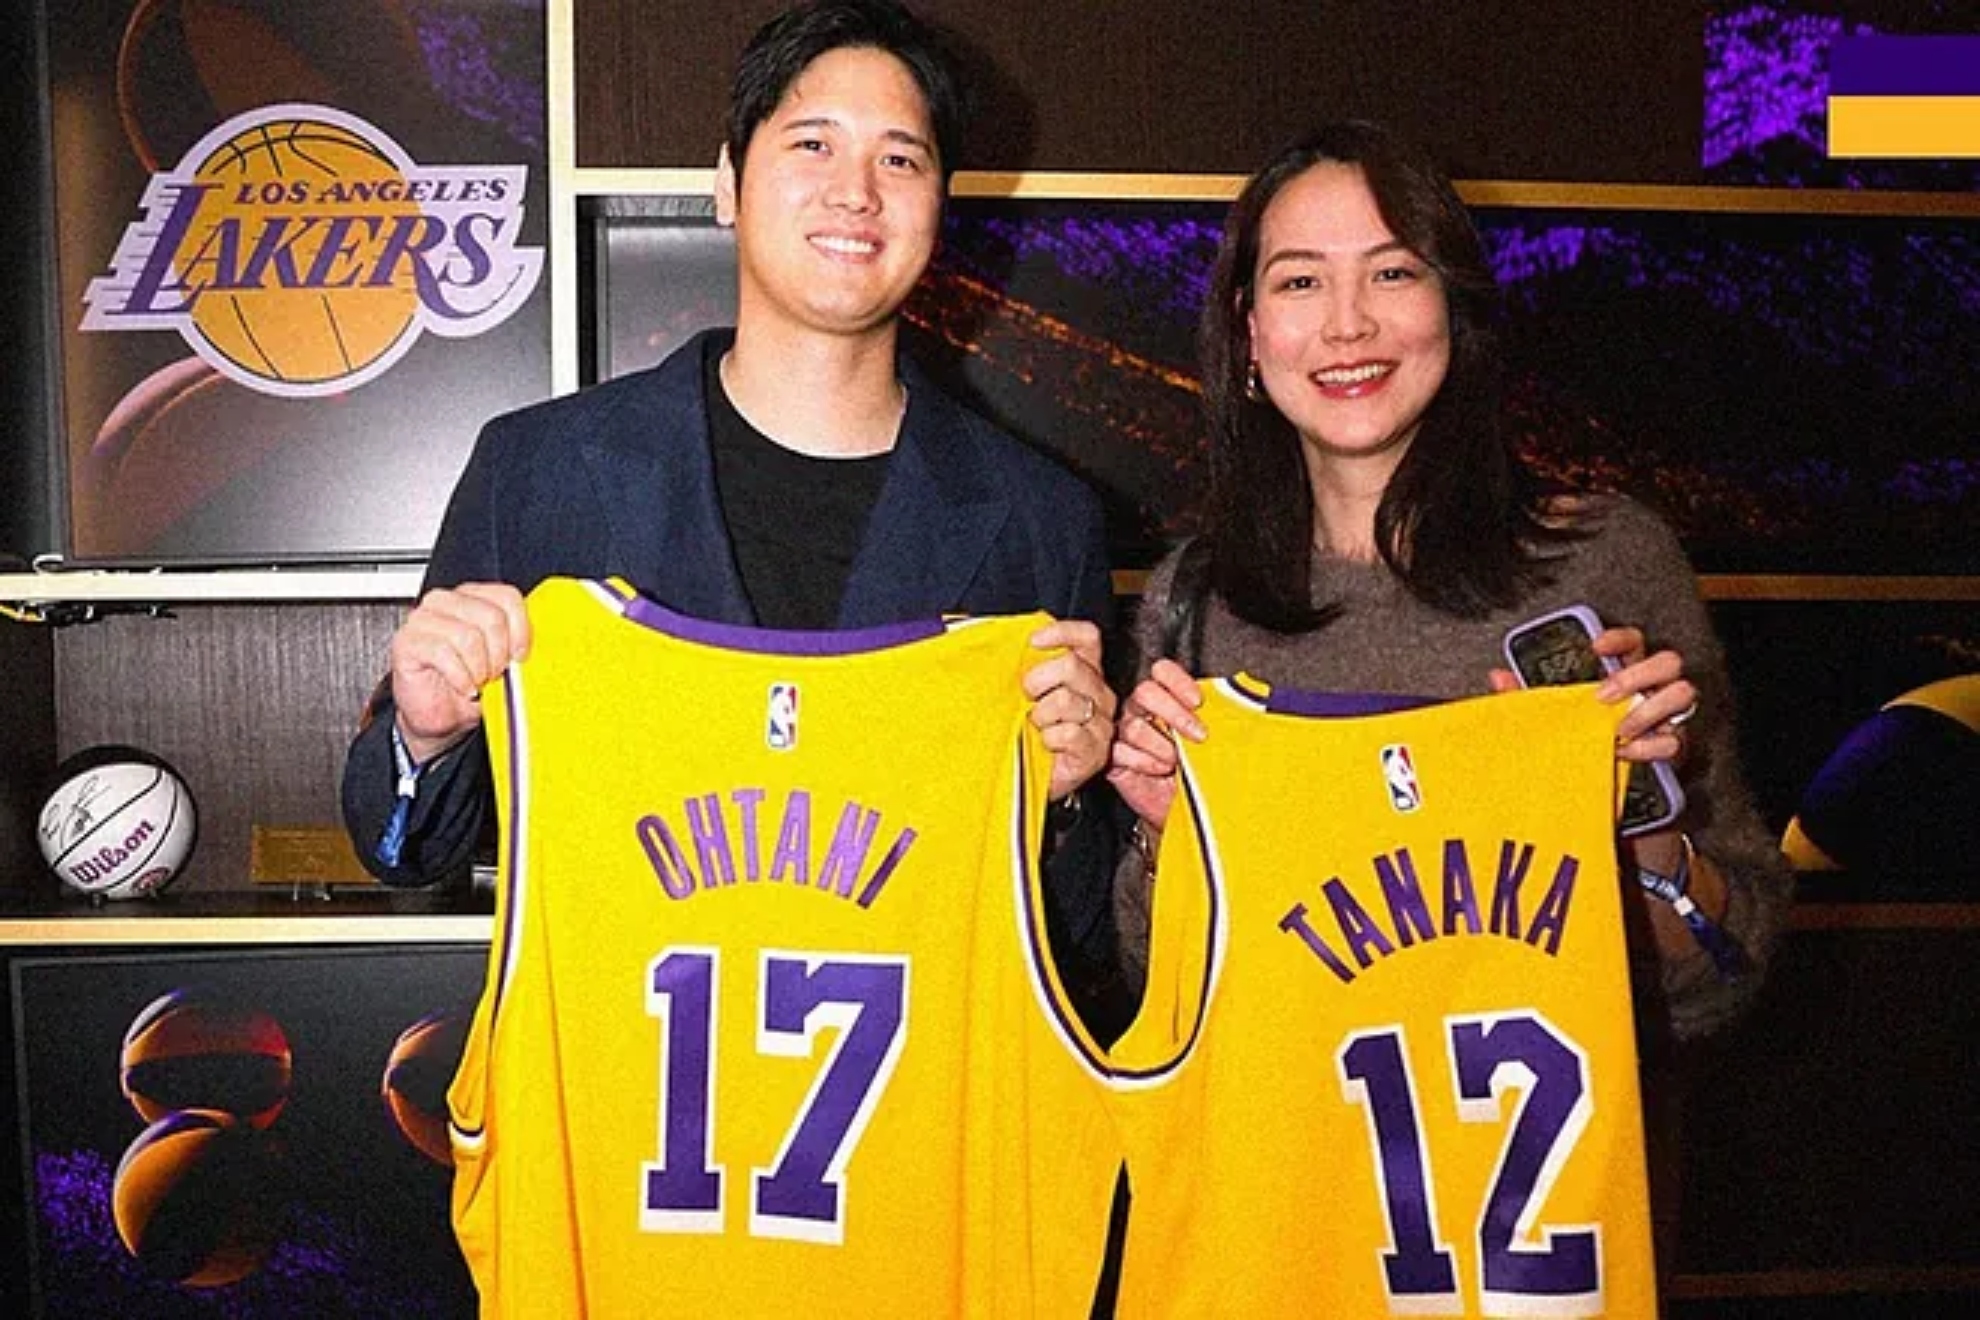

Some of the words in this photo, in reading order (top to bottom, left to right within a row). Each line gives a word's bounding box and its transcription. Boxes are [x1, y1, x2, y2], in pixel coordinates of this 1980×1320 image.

[104, 183, 525, 318] LAKERS
[236, 180, 309, 204] LOS
[317, 179, 507, 201] ANGELES
[69, 820, 154, 884] Wilson
[636, 788, 918, 909] OHTANI
[1278, 838, 1579, 984] TANAKA
[640, 945, 911, 1246] 17
[1334, 1007, 1604, 1318] 12
